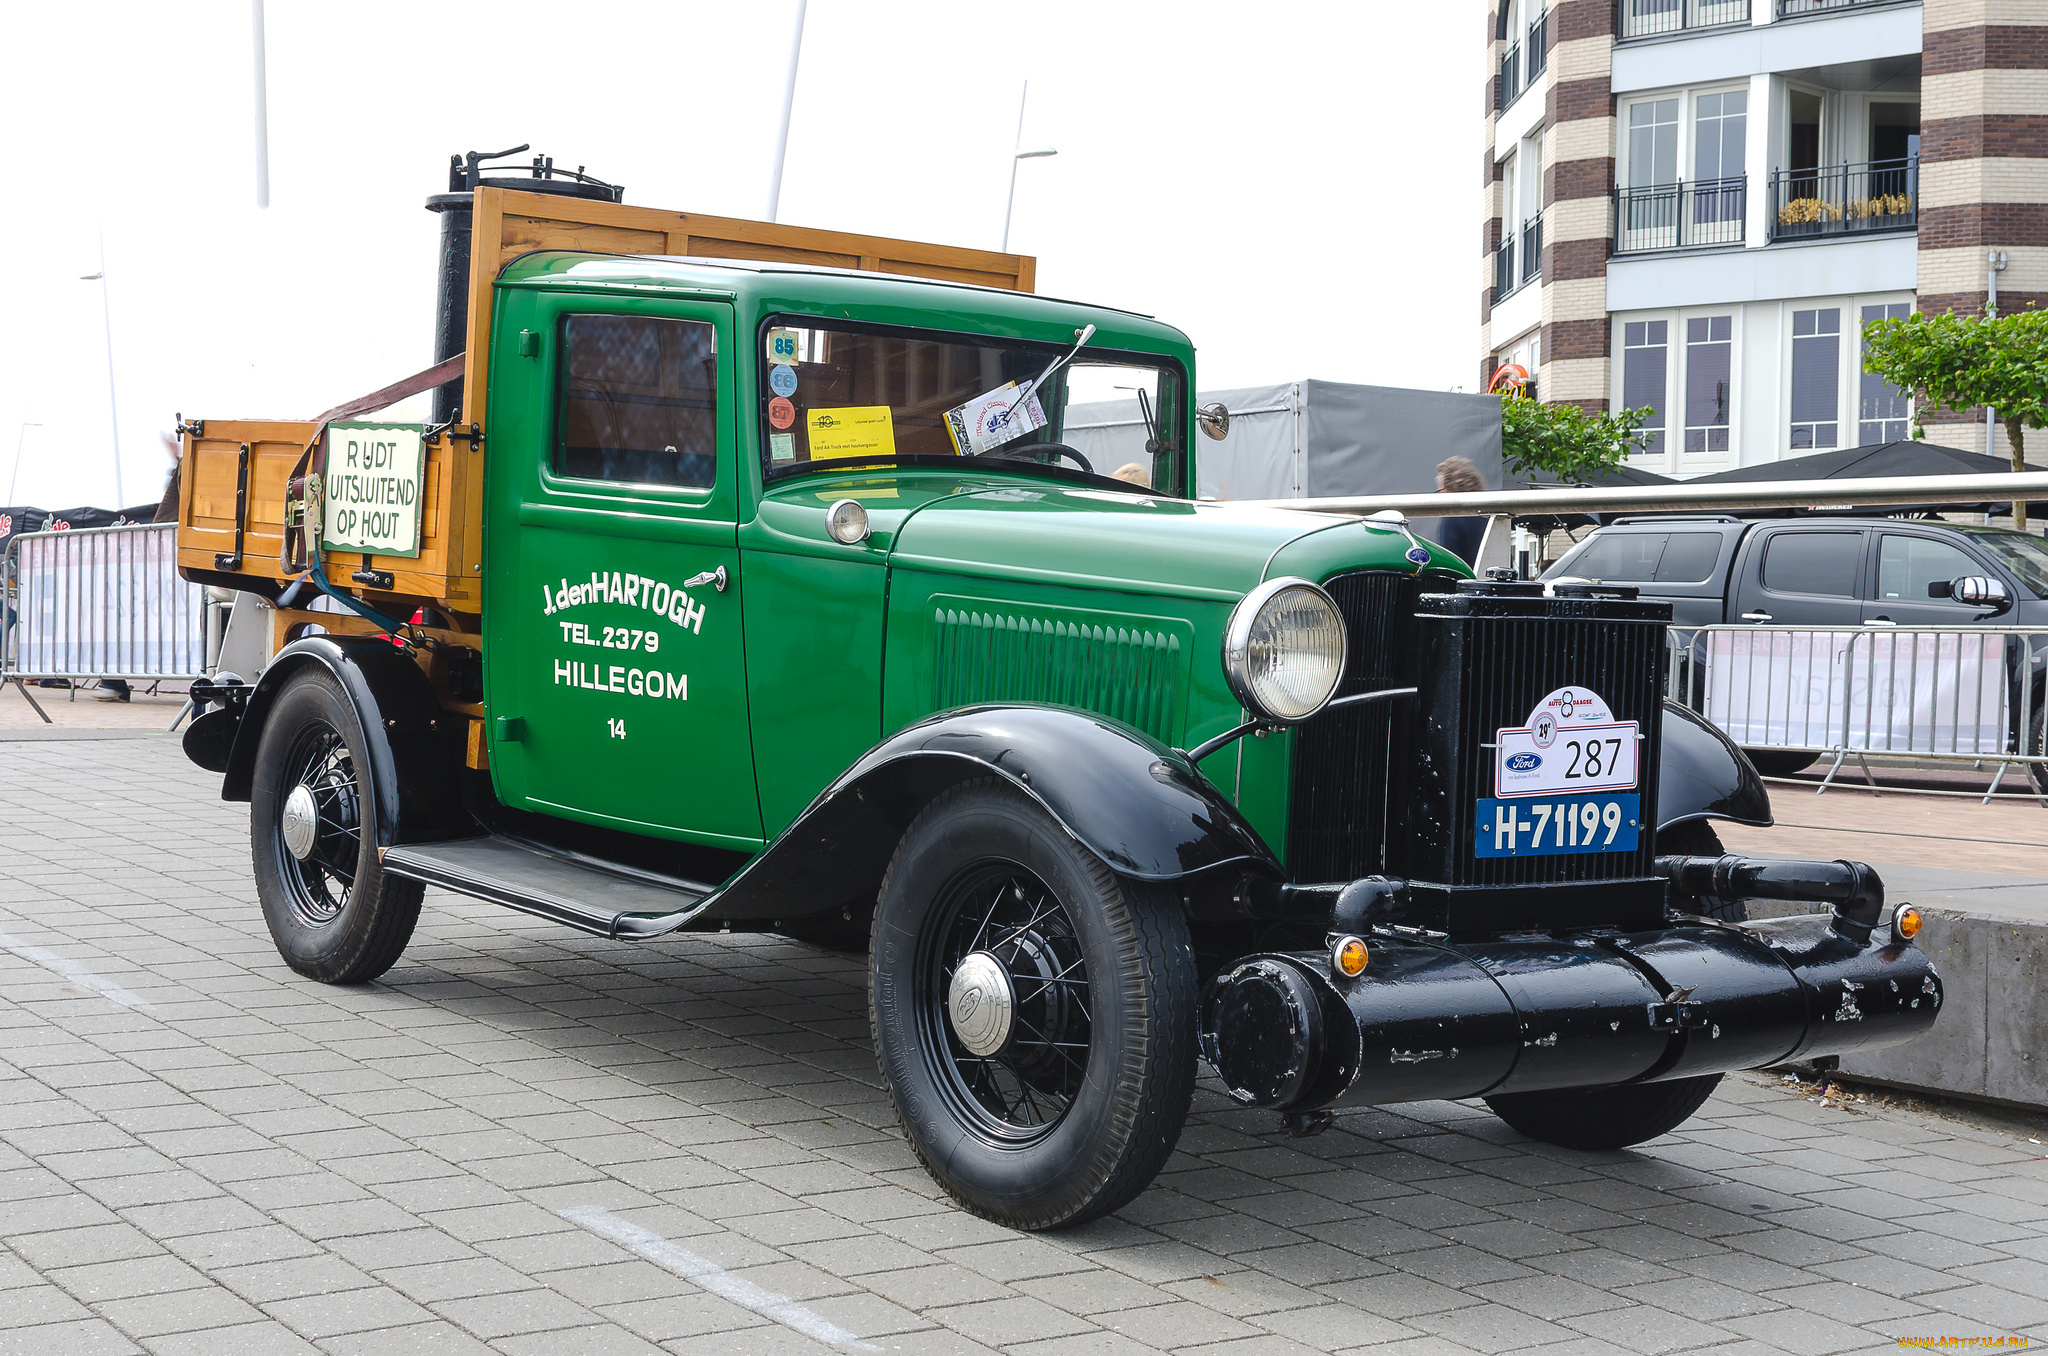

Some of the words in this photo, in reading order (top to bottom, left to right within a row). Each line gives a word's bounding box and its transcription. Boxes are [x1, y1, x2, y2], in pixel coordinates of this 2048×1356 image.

[775, 338, 794, 355] 85
[774, 374, 794, 389] 86
[771, 405, 791, 420] 87
[330, 474, 415, 506] UITSLUITEND
[337, 509, 357, 538] OP
[361, 510, 400, 540] HOUT
[554, 658, 688, 701] HILLEGOM
[1561, 691, 1574, 718] 8
[606, 717, 627, 740] 14
[1512, 755, 1536, 769] Ford
[1565, 738, 1622, 779] 287
[1494, 801, 1622, 851] H-71199
